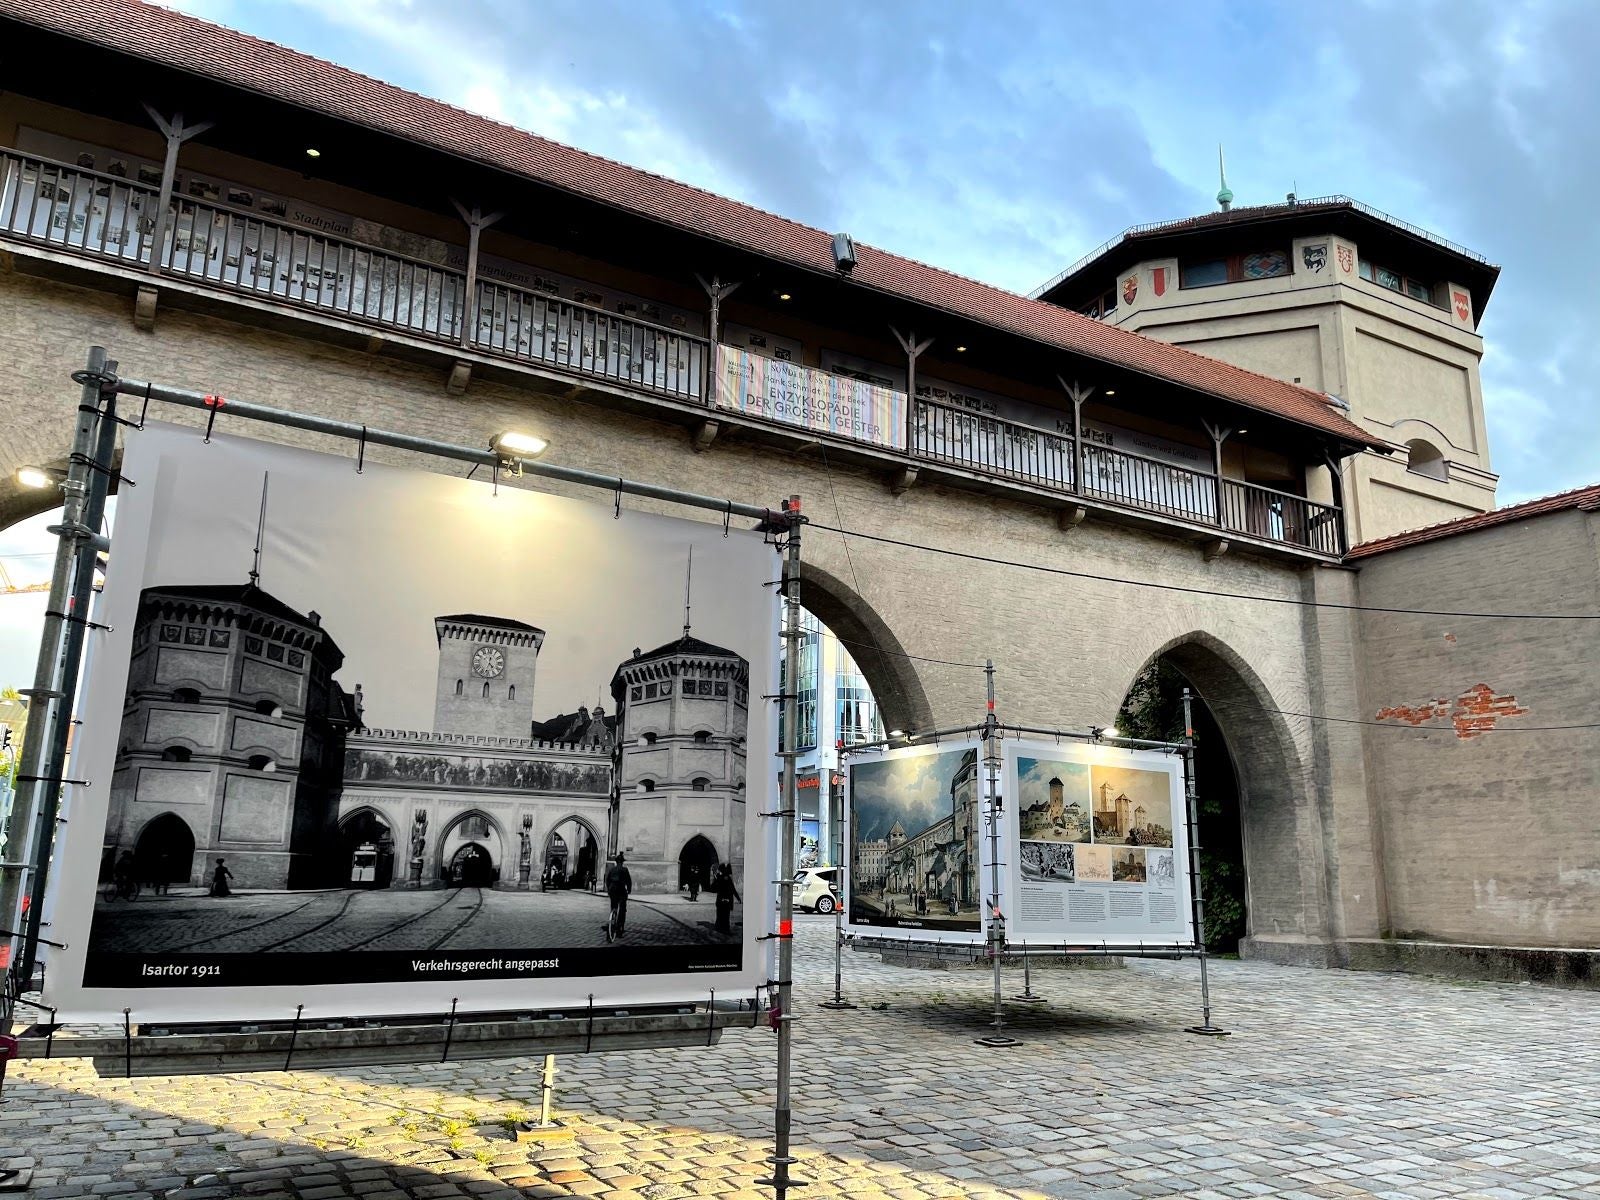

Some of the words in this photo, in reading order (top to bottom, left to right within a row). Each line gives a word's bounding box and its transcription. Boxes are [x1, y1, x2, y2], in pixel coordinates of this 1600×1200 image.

[292, 211, 349, 234] Stadtplan
[477, 263, 530, 283] ergnügens
[763, 374, 786, 387] Hank
[787, 380, 821, 395] Schmidt
[832, 391, 845, 402] der
[746, 394, 771, 410] DER
[774, 401, 831, 424] GROSSEN
[835, 417, 881, 436] GEISTER
[769, 388, 860, 419] ENZYKLOPÄDIE
[142, 963, 190, 976] Isartor
[191, 965, 221, 978] 1911
[411, 958, 503, 973] Verkehrsgerecht
[504, 957, 560, 971] angepasst
